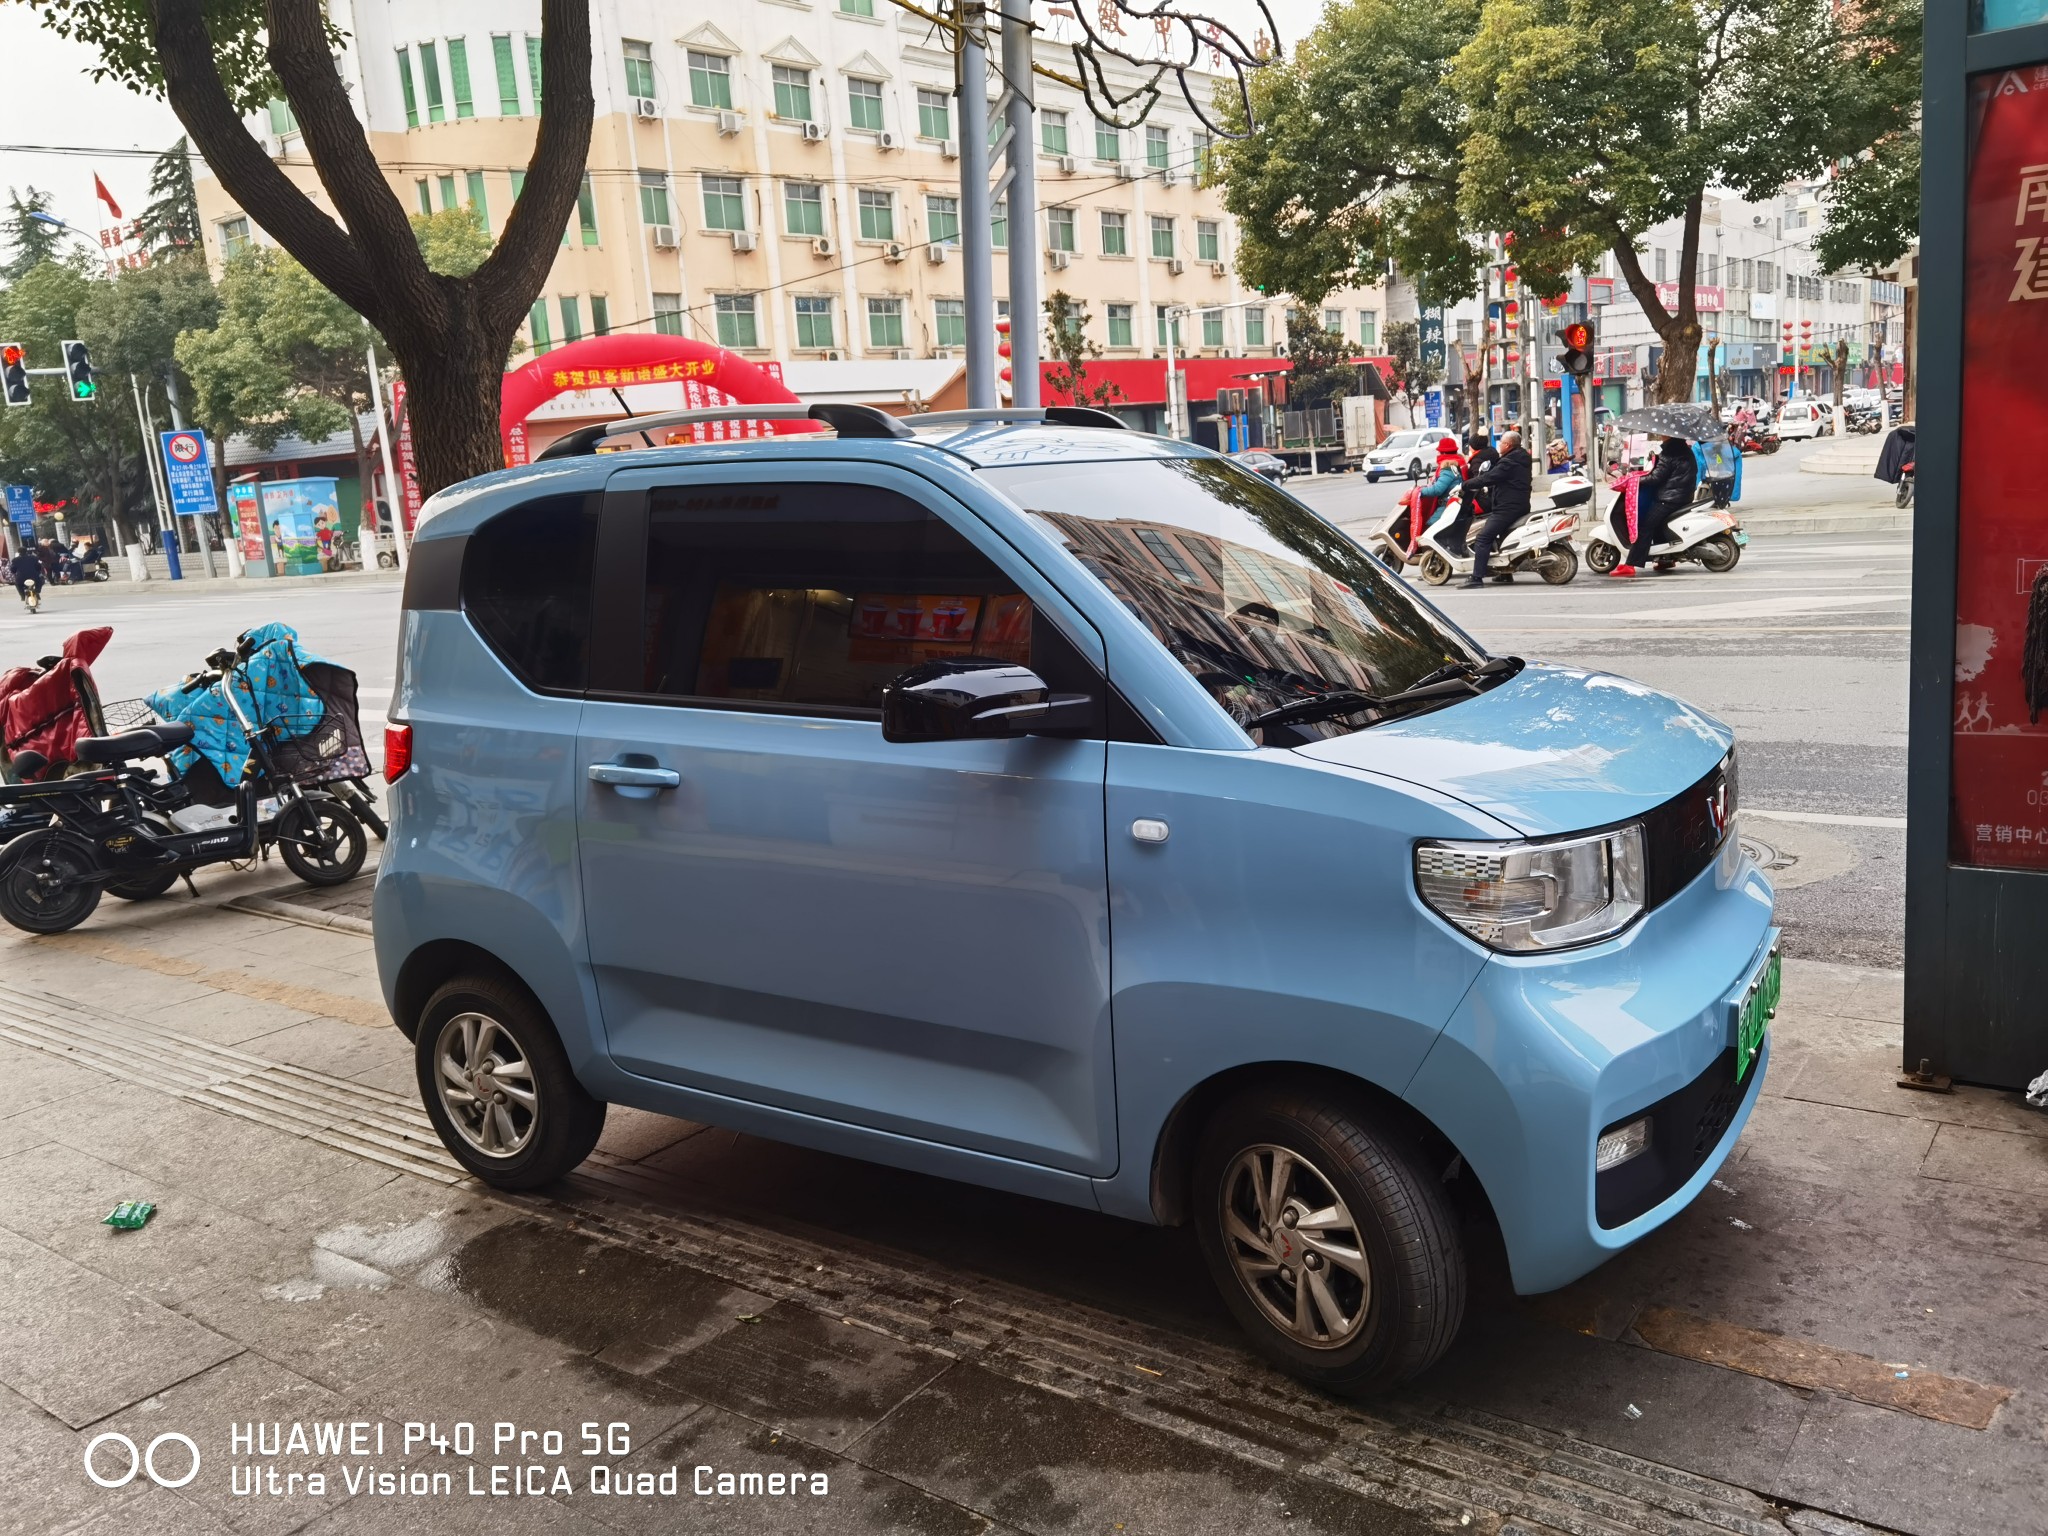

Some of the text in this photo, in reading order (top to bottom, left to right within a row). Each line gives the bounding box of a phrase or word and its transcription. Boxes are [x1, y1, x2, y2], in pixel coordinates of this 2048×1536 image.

[553, 359, 716, 388] 恭贺贝客新语盛大开业
[1976, 823, 2048, 845] 营销中心
